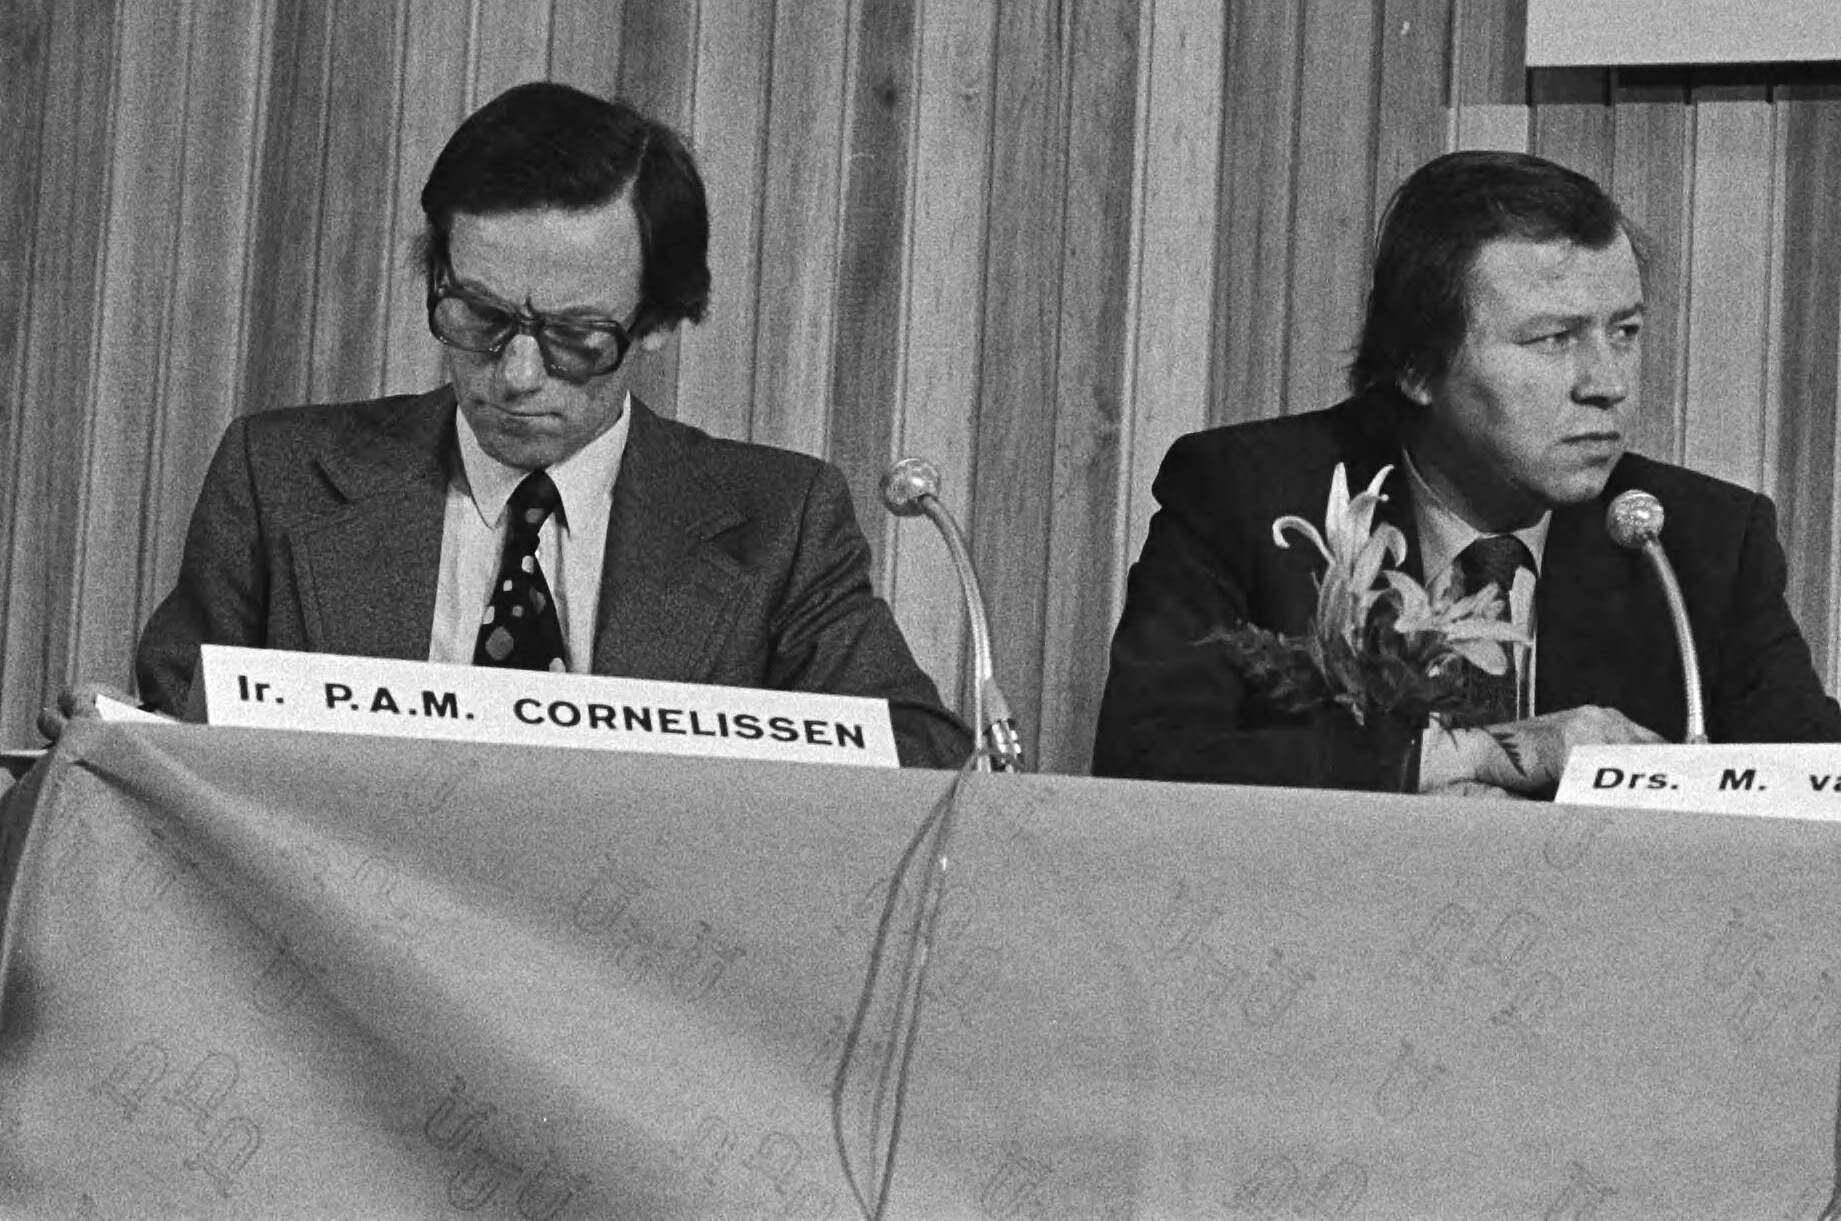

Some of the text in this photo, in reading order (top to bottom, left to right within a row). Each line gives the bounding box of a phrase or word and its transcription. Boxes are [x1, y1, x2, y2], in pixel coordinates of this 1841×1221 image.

[237, 674, 867, 750] Ir. P.A.M. CORNELISSEN
[1592, 767, 1679, 791] Drs.
[1718, 768, 1766, 792] M.
